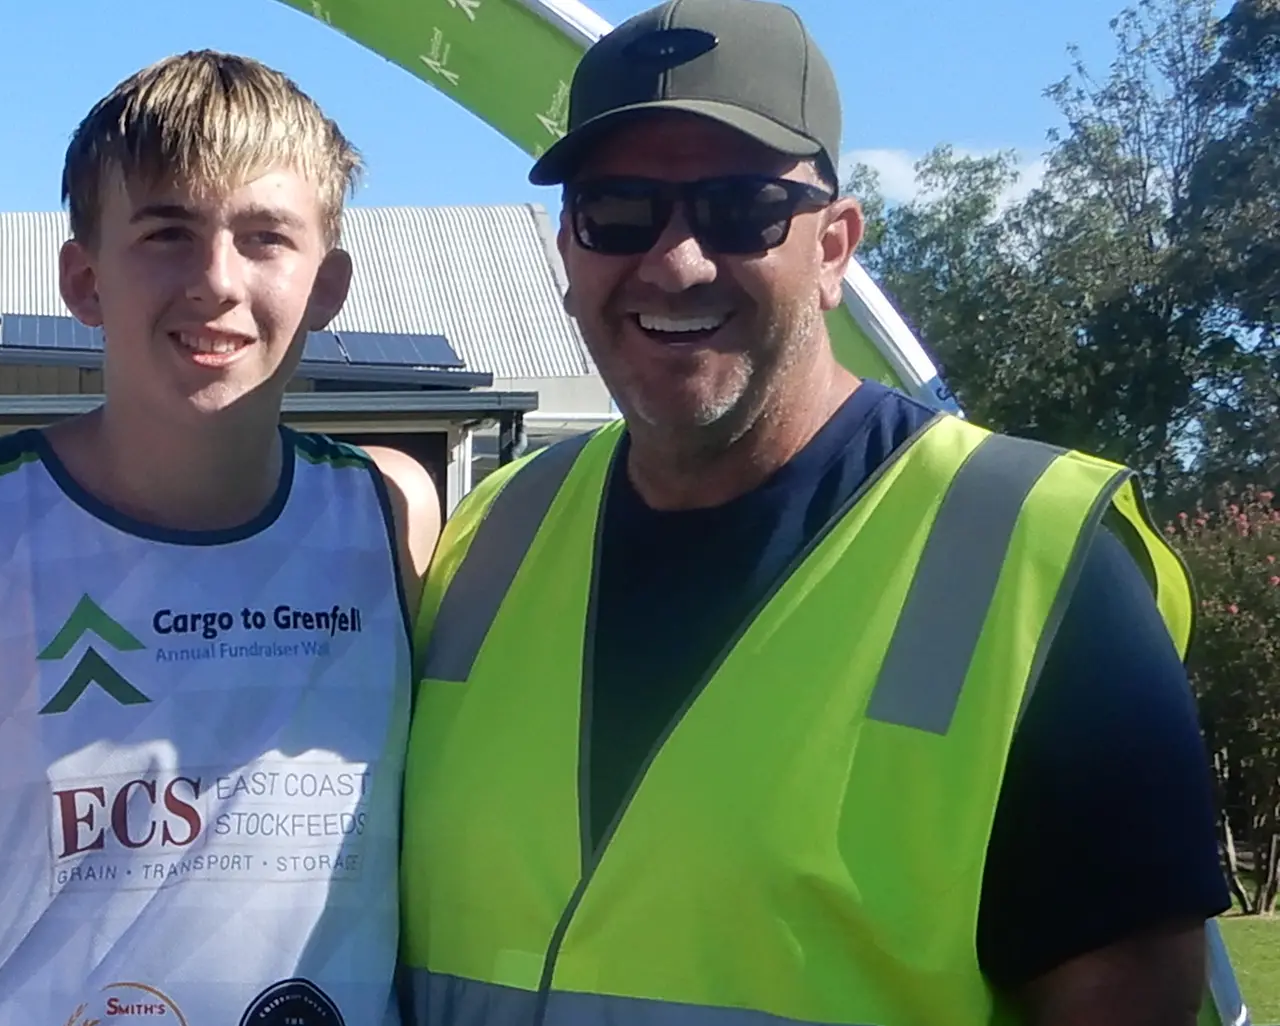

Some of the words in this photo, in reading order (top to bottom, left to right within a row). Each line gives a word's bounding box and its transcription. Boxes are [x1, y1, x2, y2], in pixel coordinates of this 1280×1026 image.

[153, 609, 233, 639] Cargo
[241, 607, 266, 629] to
[274, 605, 361, 637] Grenfell
[156, 644, 215, 663] Annual
[220, 641, 298, 659] Fundraiser
[54, 776, 201, 858] ECS
[216, 772, 279, 799] EAST
[284, 772, 370, 797] COAST
[215, 812, 366, 837] STOCKFEEDS
[57, 867, 117, 884] GRAIN
[142, 854, 254, 879] TRANSPORT
